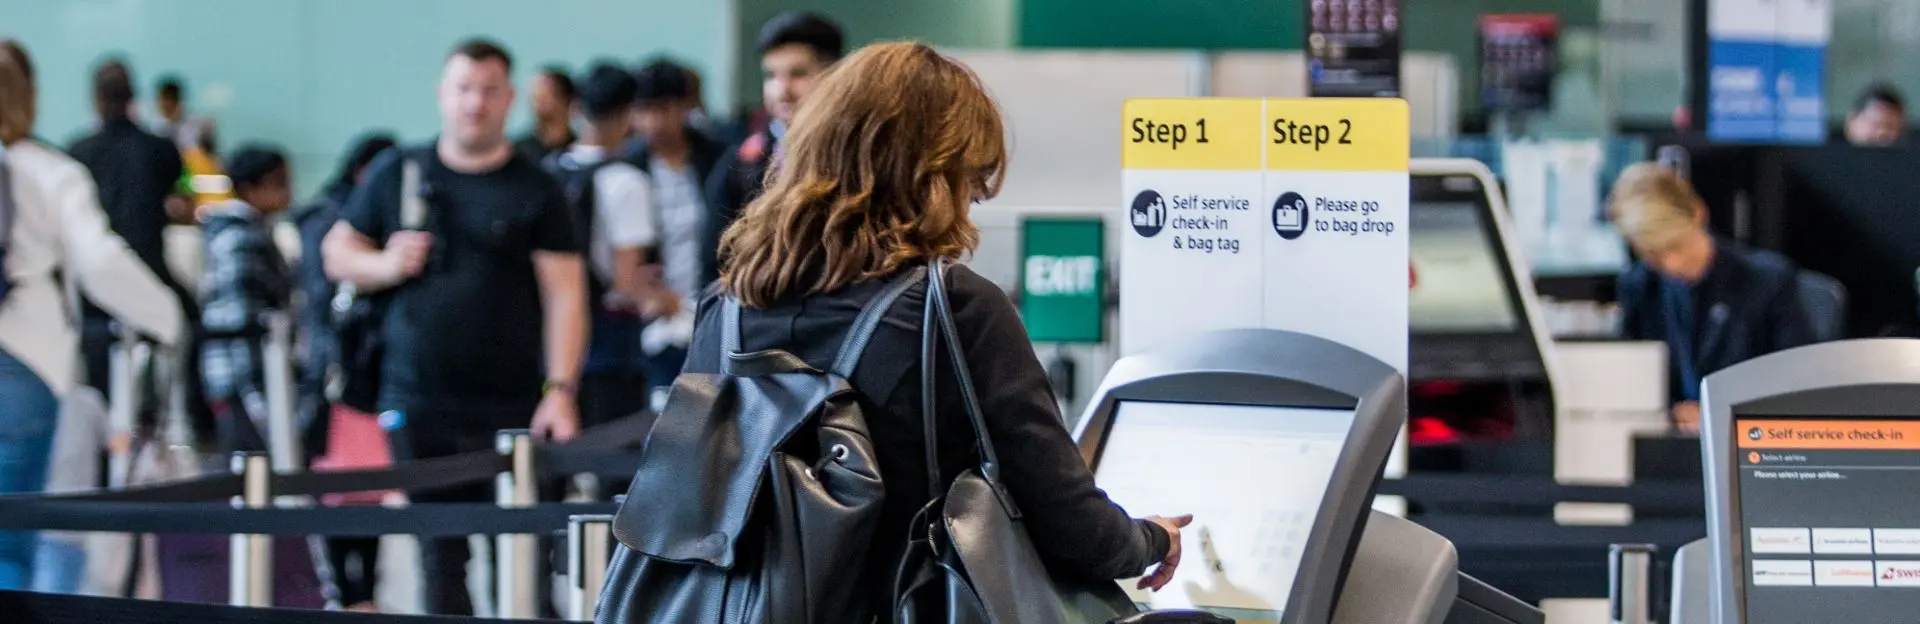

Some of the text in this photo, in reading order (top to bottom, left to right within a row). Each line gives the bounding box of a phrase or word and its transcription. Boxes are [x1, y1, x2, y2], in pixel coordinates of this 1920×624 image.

[1132, 117, 1209, 150] Step 1
[1273, 118, 1352, 151] Step 2
[1172, 195, 1250, 211] Self service
[1315, 197, 1379, 218] Please go
[1172, 215, 1228, 231] check-in
[1315, 218, 1395, 237] to bag drop
[1173, 235, 1240, 254] & bag tag
[1026, 255, 1099, 296] EXIT
[1767, 428, 1904, 440] Self service check-in
